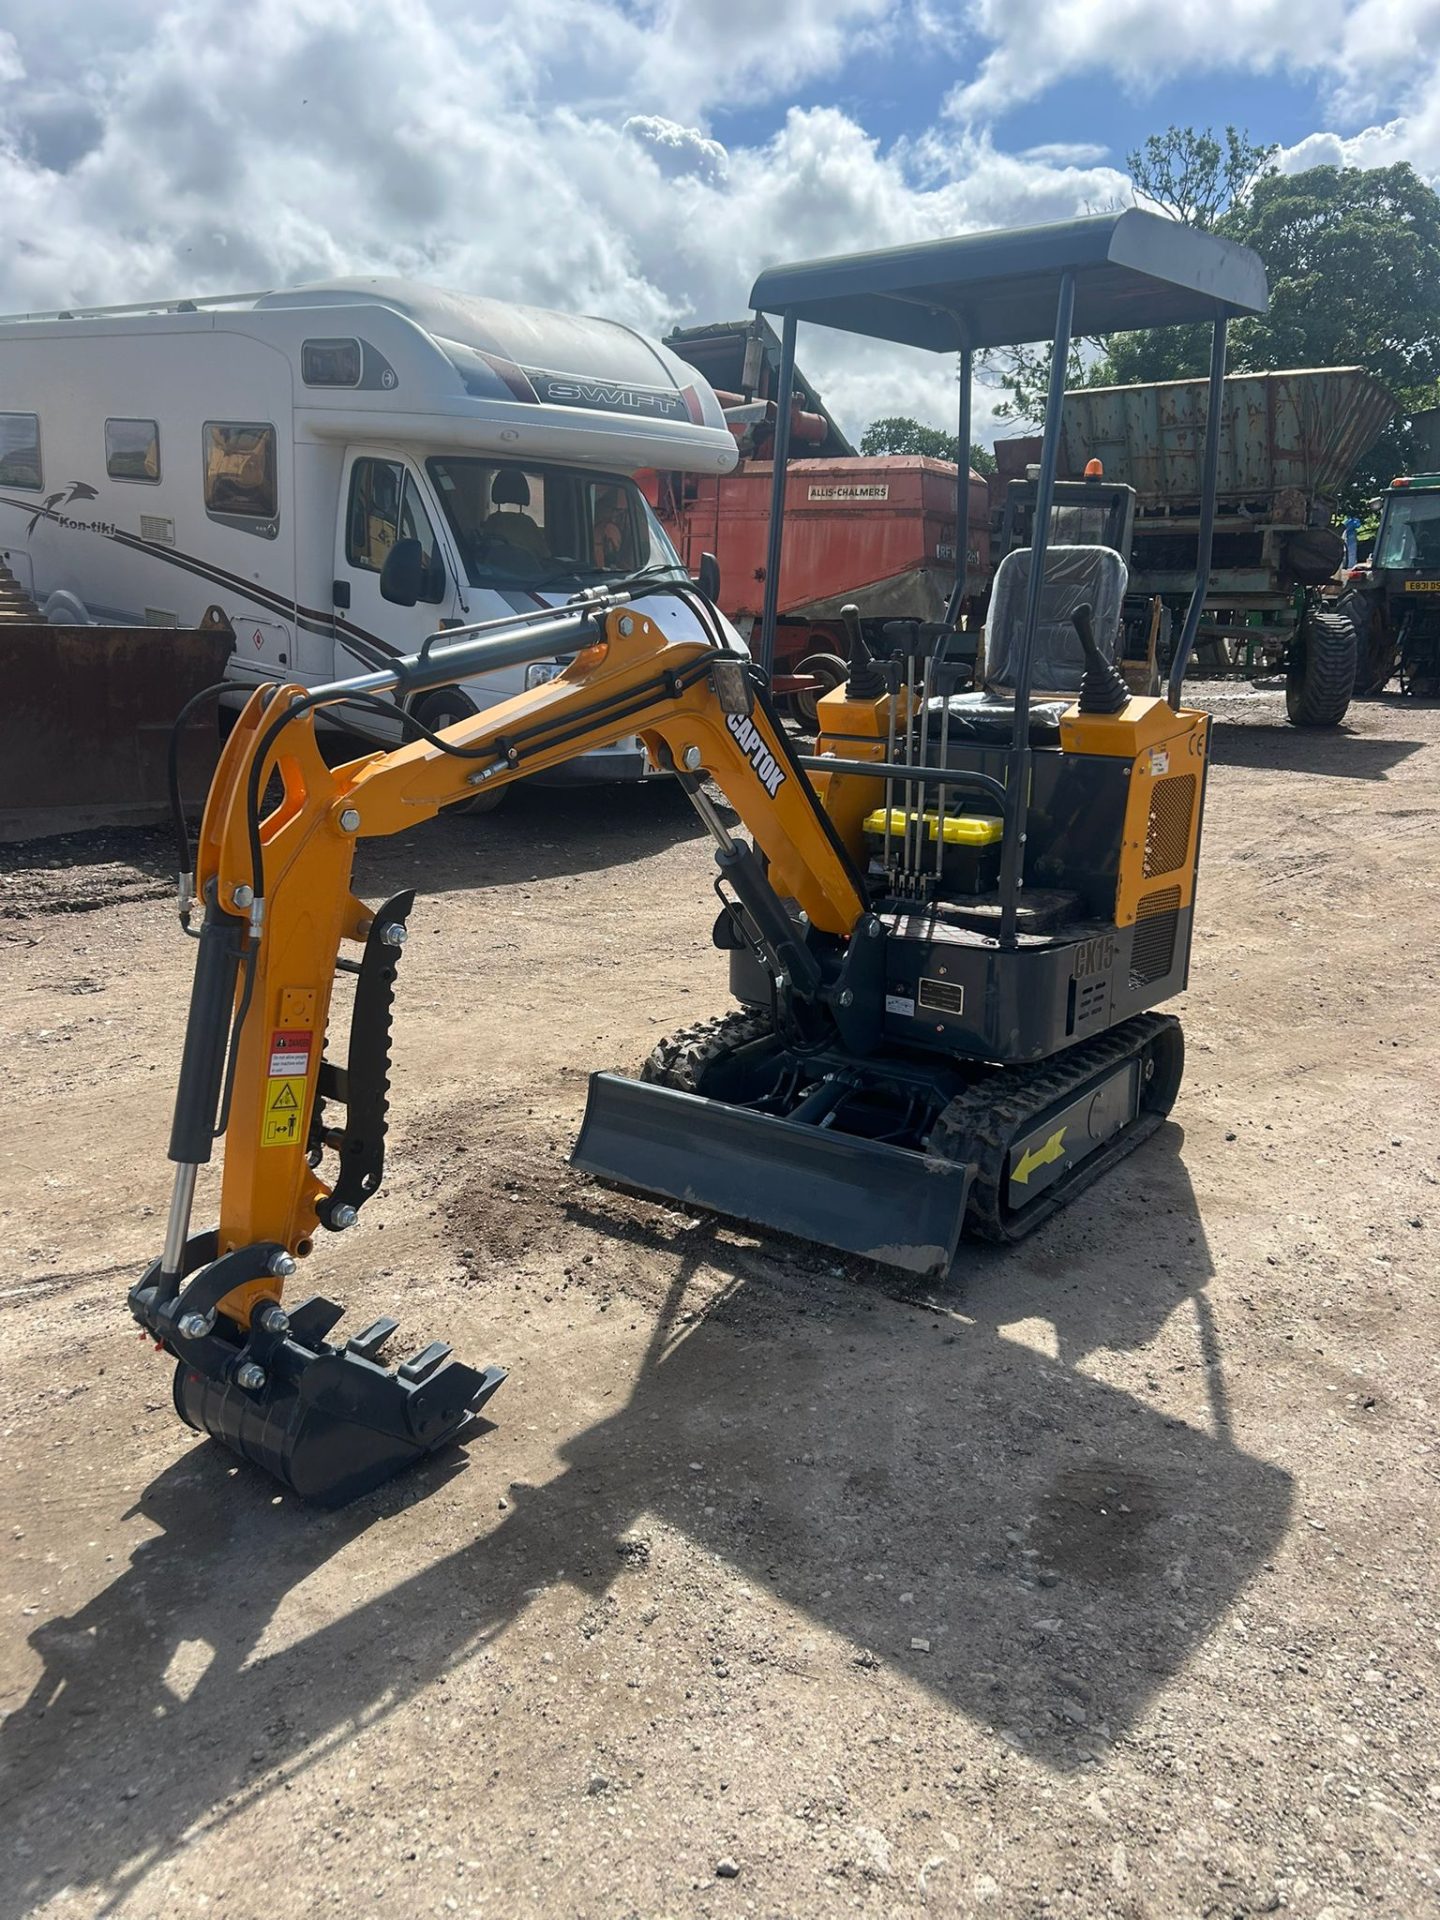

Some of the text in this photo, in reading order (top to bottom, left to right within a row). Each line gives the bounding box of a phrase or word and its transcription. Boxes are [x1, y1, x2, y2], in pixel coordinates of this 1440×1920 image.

[548, 382, 676, 413] SWIFT
[810, 488, 887, 497] ALLIS-CHALMERS
[59, 516, 115, 535] Kon-tiki
[726, 713, 786, 797] CAPTOK
[1073, 936, 1114, 980] CK15
